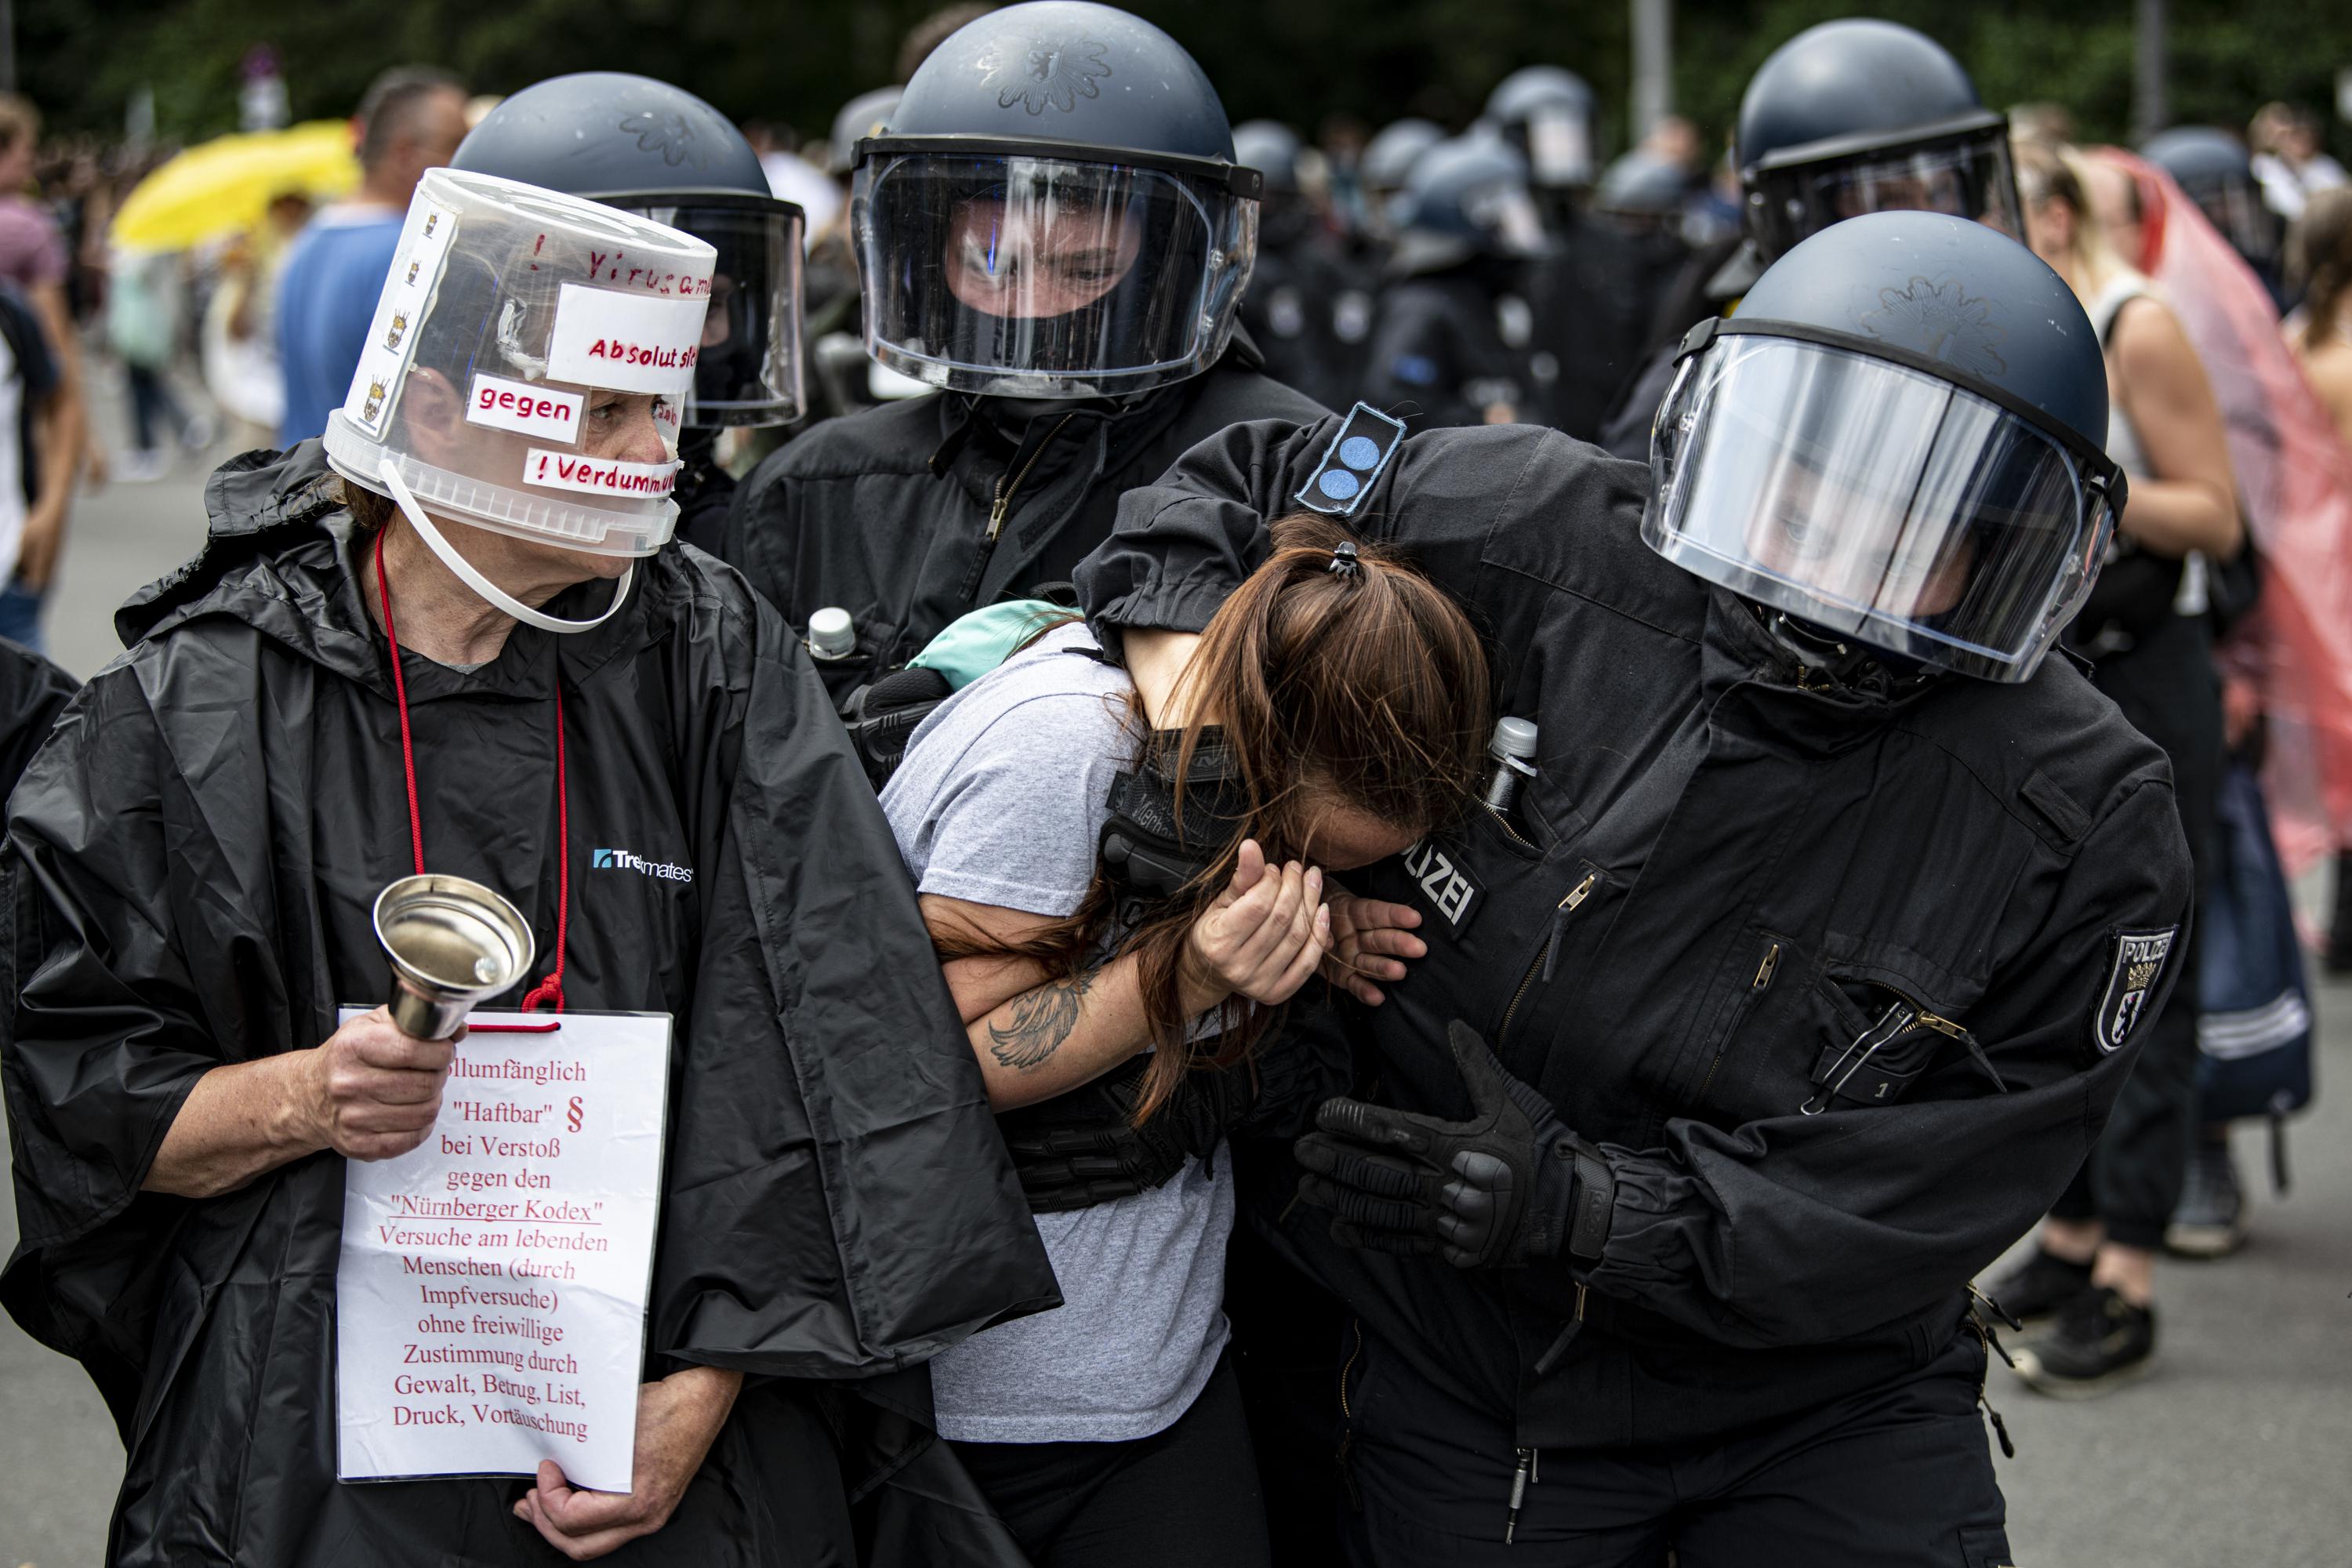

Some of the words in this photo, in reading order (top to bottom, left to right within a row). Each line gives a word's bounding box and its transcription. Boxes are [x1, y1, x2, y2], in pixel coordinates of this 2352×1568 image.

[590, 339, 677, 368] Absolut
[479, 388, 571, 421] gegen
[453, 1102, 552, 1123] "Haftbar"
[441, 1134, 472, 1155] bei
[480, 1136, 561, 1159] Verstoß
[446, 1171, 508, 1191] gegen
[514, 1168, 551, 1189] den
[390, 1194, 519, 1221] "Nürnberger
[524, 1200, 603, 1221] Kodex"
[379, 1225, 472, 1247] Versuche
[478, 1233, 509, 1247] am
[516, 1229, 608, 1252] lebenden
[403, 1256, 502, 1277] Menschen
[509, 1258, 575, 1282] (durch
[421, 1285, 558, 1314] Impfversuche)
[418, 1315, 466, 1334] ohne
[472, 1316, 564, 1345] freiwillige
[403, 1344, 524, 1372] Zustimmung
[528, 1350, 579, 1374] durch
[394, 1374, 476, 1396] Gewalt,
[482, 1374, 541, 1405] Betrug,
[546, 1383, 586, 1407] List,
[394, 1404, 465, 1427] Druck,
[472, 1404, 589, 1443] Vortäuschung
